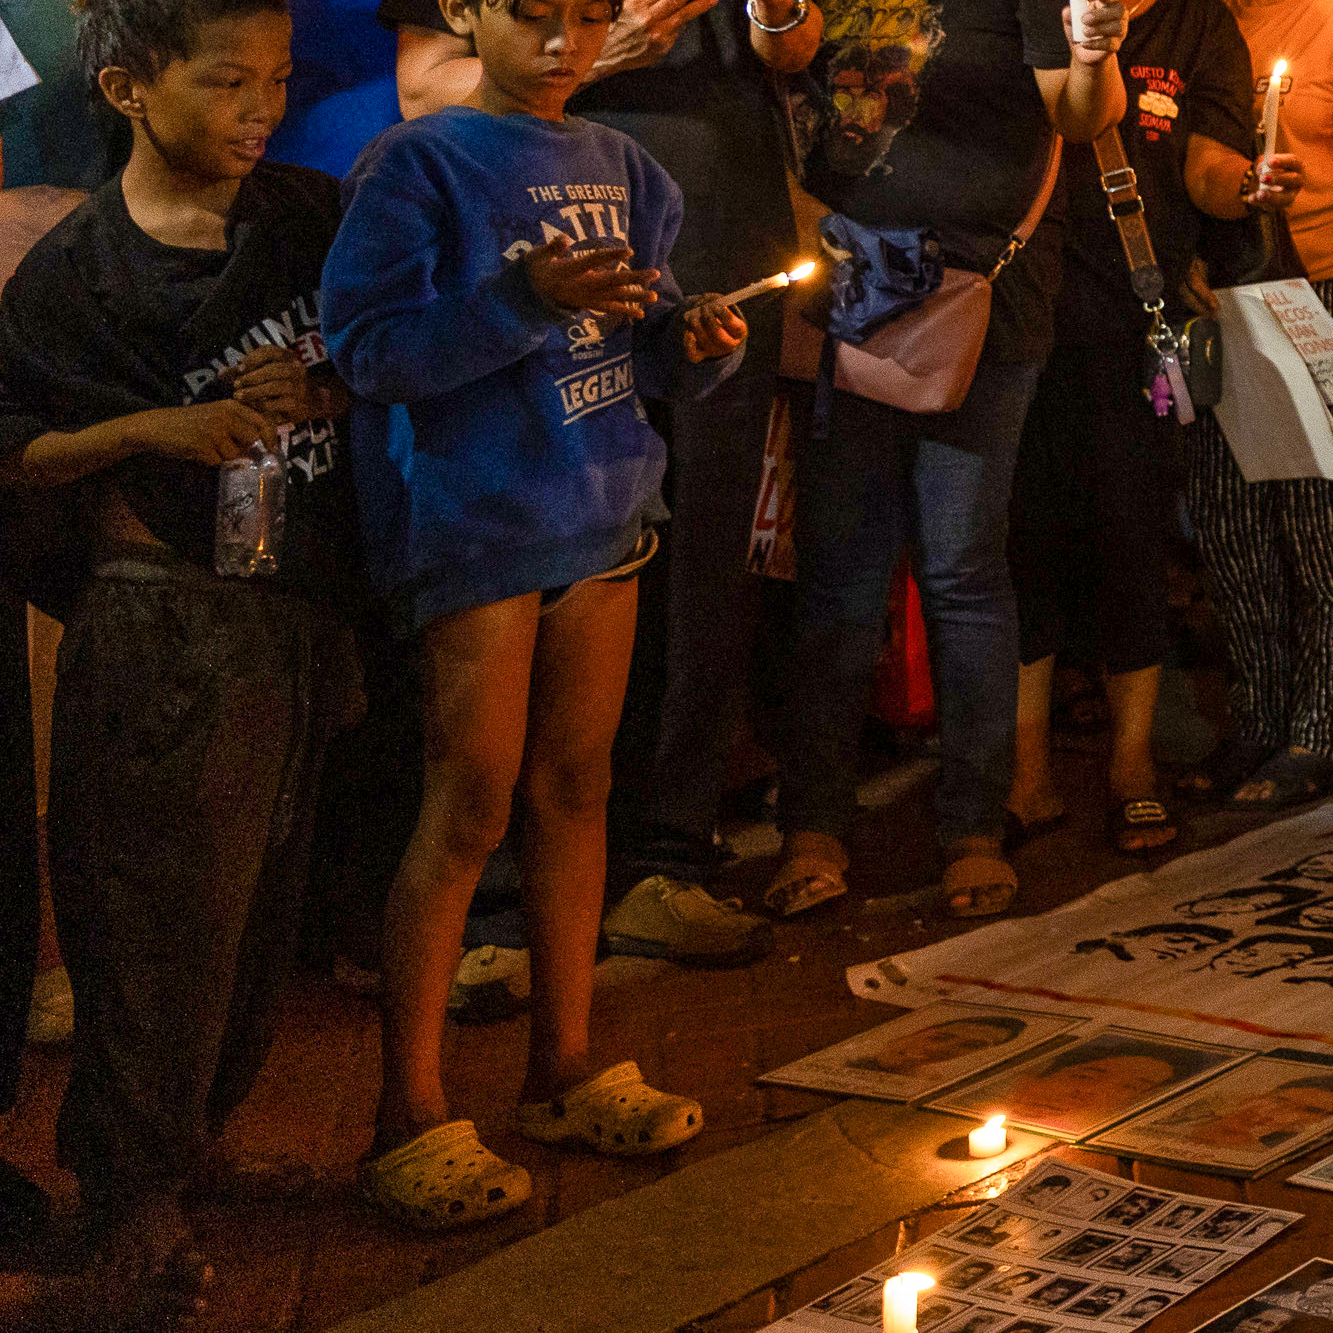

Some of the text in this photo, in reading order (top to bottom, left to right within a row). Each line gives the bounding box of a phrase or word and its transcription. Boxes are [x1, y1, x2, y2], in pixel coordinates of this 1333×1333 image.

[526, 183, 630, 205] THE GREATEST
[559, 359, 634, 415] LEGEN
